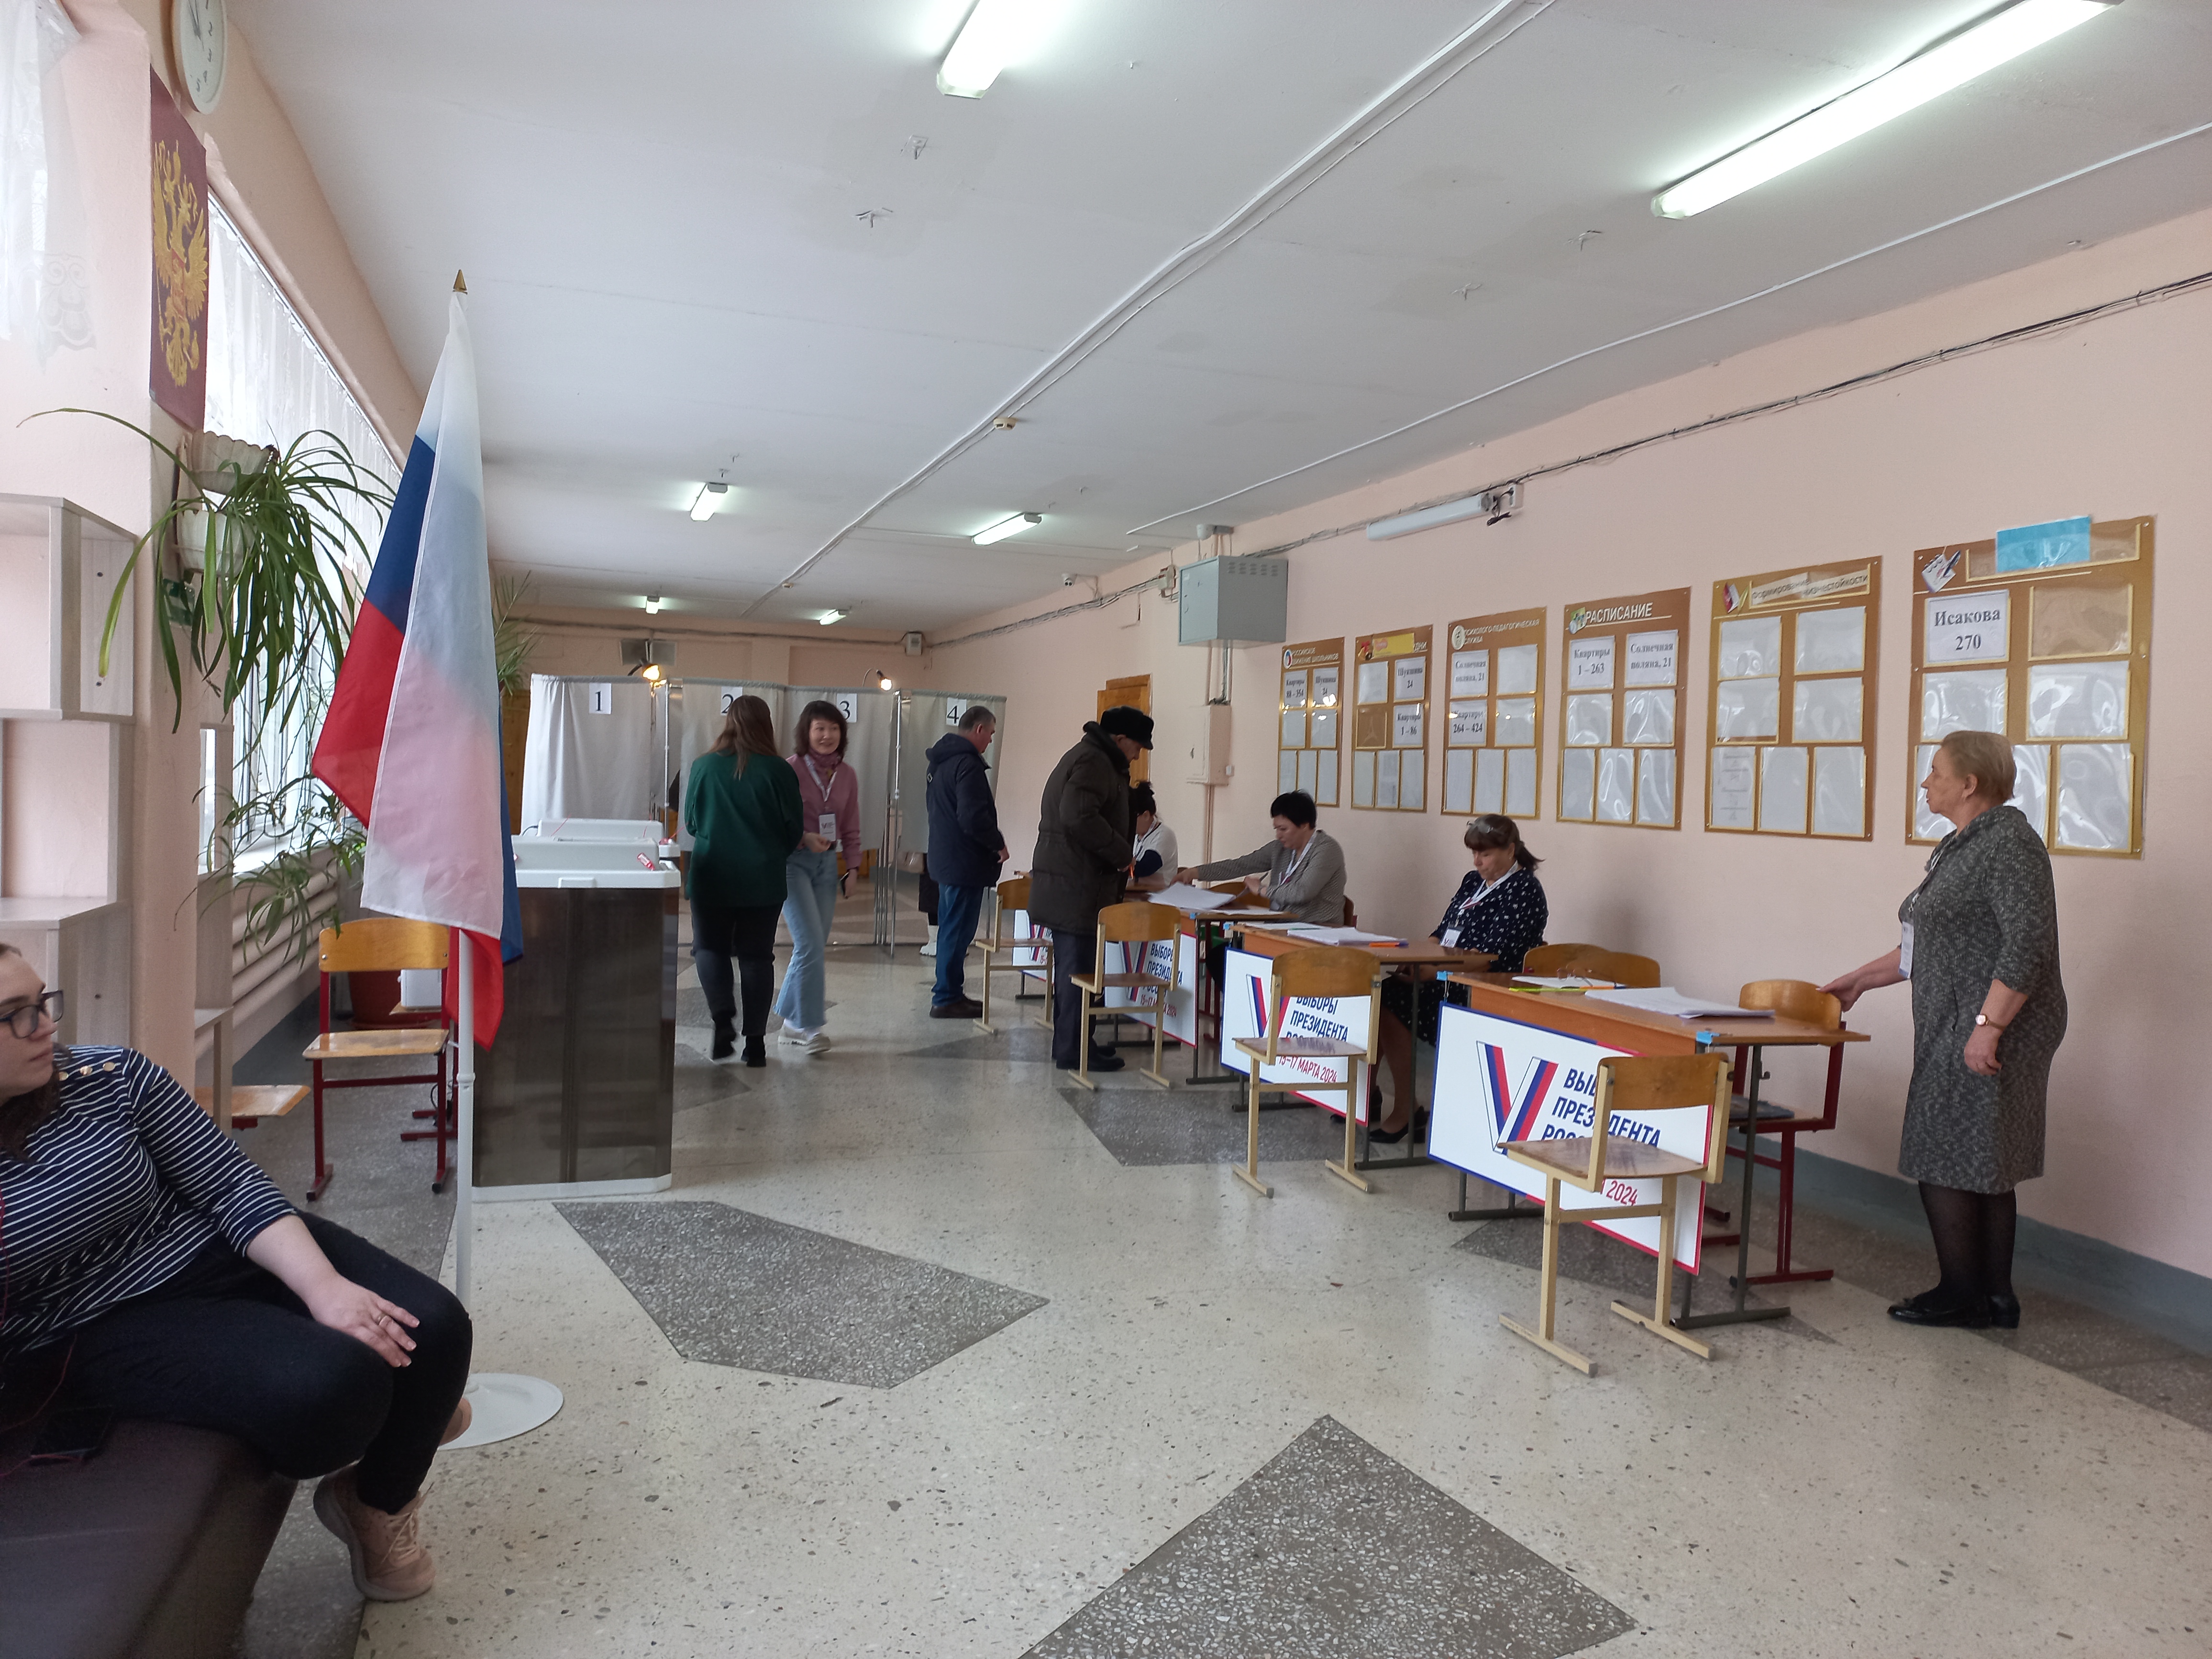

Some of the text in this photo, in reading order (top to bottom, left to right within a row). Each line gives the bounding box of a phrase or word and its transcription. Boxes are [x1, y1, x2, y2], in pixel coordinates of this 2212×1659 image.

[1585, 602, 1653, 623] РАСПИСАНИЕ
[1935, 609, 2001, 627] Исакова
[1630, 643, 1674, 653] Солнечная
[1956, 634, 1981, 651] 270
[1574, 648, 1611, 660] Квартиры
[1663, 657, 1671, 667] 21
[1456, 660, 1487, 669] Солнечная
[1591, 663, 1604, 675] 263
[595, 691, 601, 712] 1
[721, 694, 733, 714] 2
[840, 700, 851, 720] 3
[947, 705, 959, 724] 4
[1290, 1009, 1349, 1042] ПРЕЗИДЕНТА
[1297, 1057, 1320, 1078] МАРТА
[1319, 1066, 1338, 1083] 2024
[1551, 1095, 1661, 1148] ПРЕЗДЕНТА
[1606, 1180, 1638, 1206] 2024
